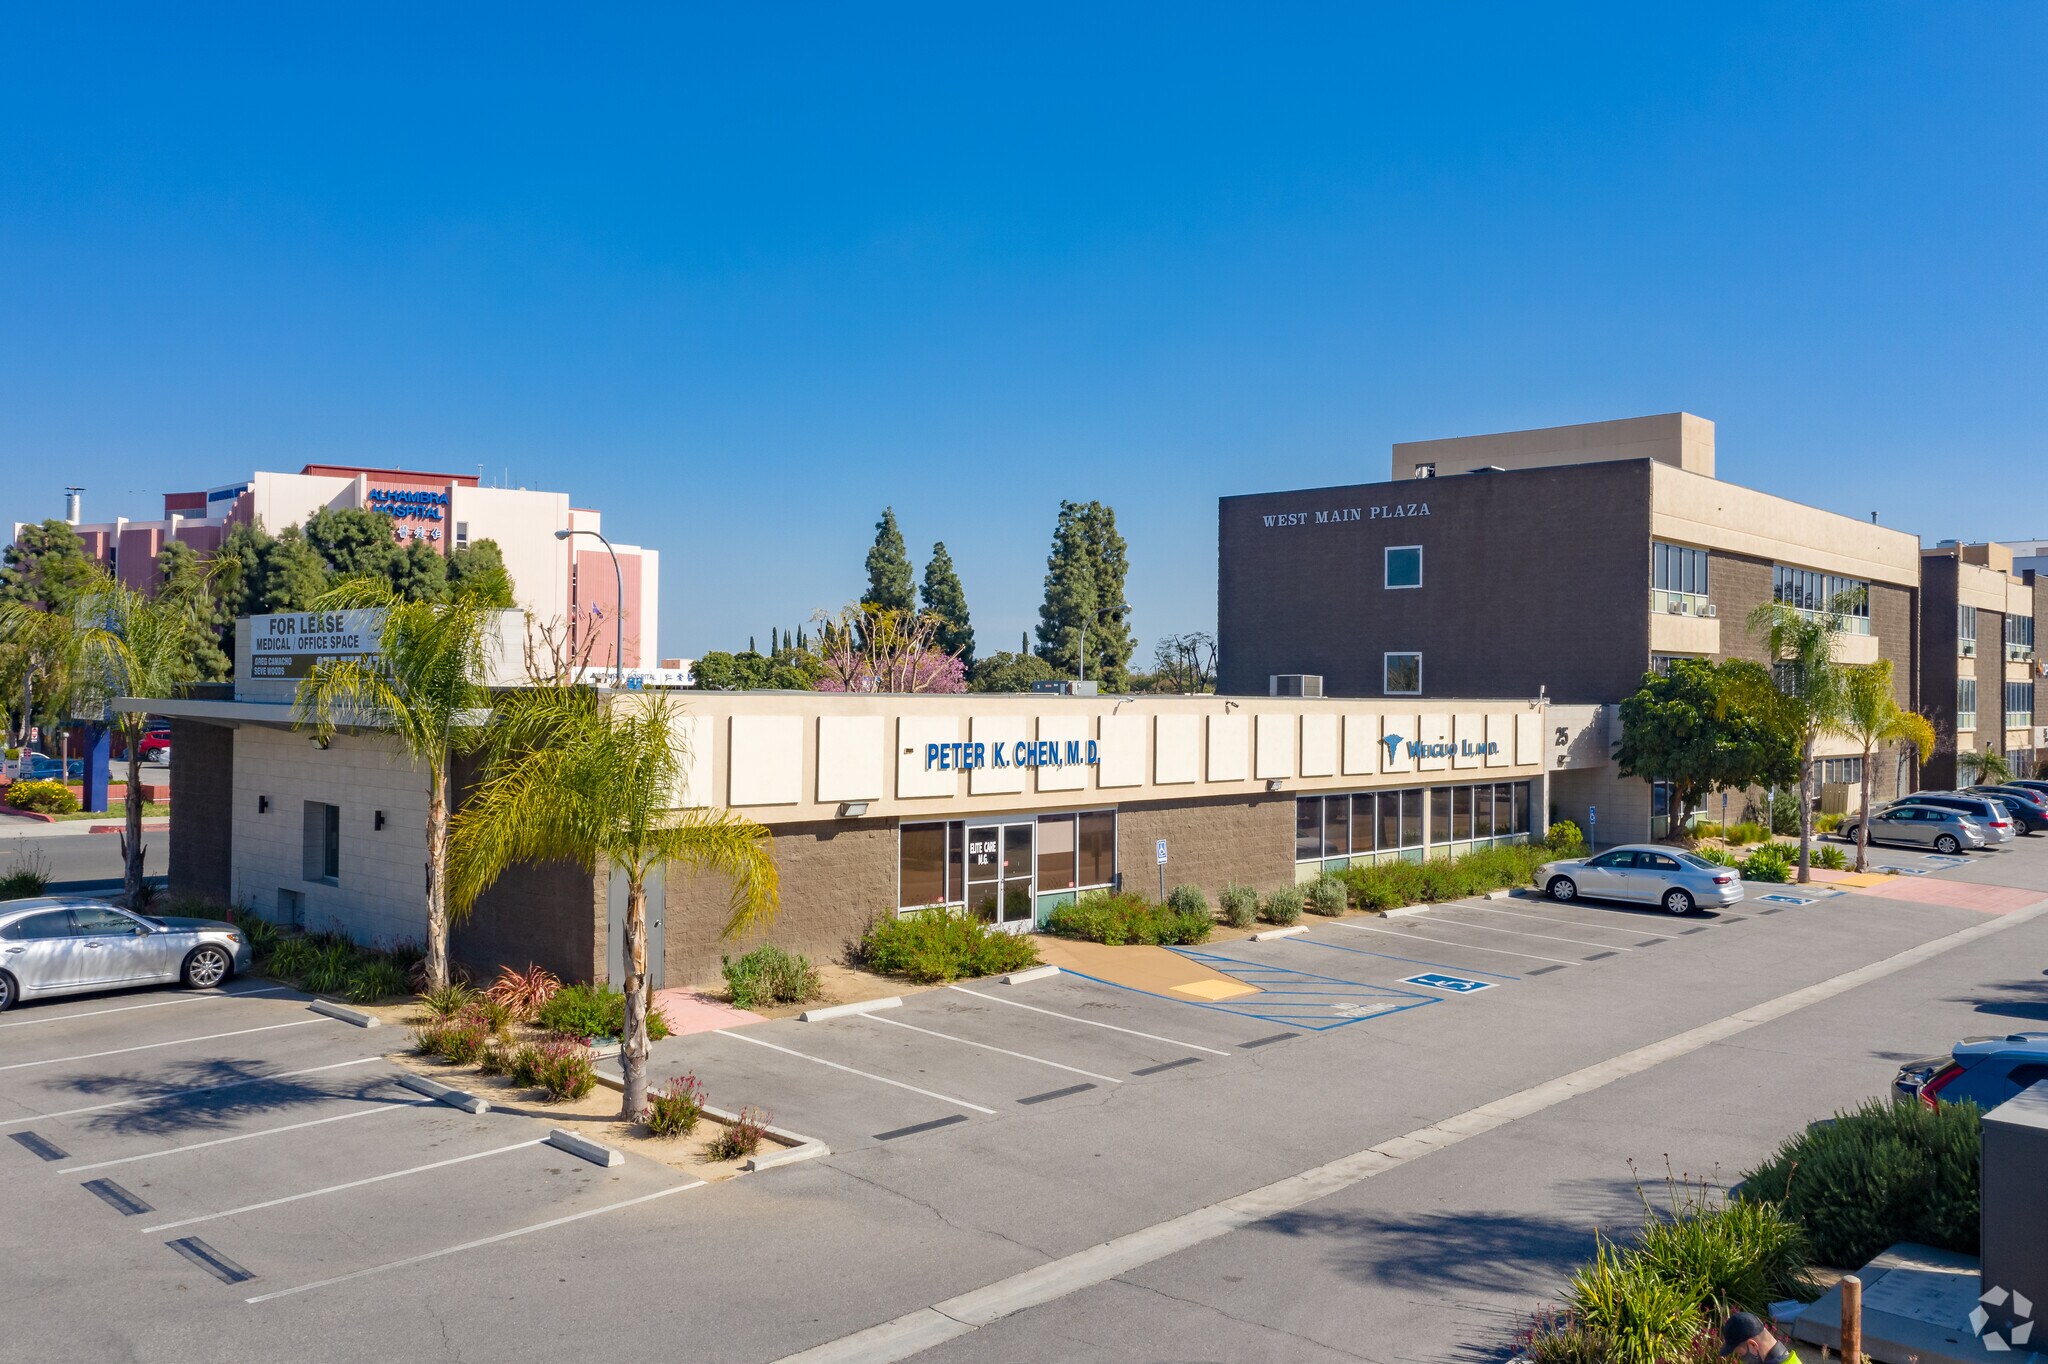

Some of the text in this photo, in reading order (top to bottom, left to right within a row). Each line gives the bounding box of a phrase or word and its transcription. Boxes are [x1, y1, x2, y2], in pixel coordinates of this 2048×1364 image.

[369, 488, 449, 505] ALHAMBRA
[373, 503, 444, 519] HOSPITAL
[1262, 502, 1431, 528] WEST MAIN PLAZA
[269, 615, 344, 635] FOR LEASE
[256, 637, 291, 651] MEDICAL
[298, 636, 328, 650] OFFICE
[330, 635, 359, 649] SPACE
[254, 657, 268, 666] GREG
[1555, 726, 1569, 746] 25
[927, 742, 985, 770] PETER
[994, 742, 1010, 767] K.
[1014, 740, 1063, 768] CHEN,
[969, 841, 997, 854] ELITE CARE
